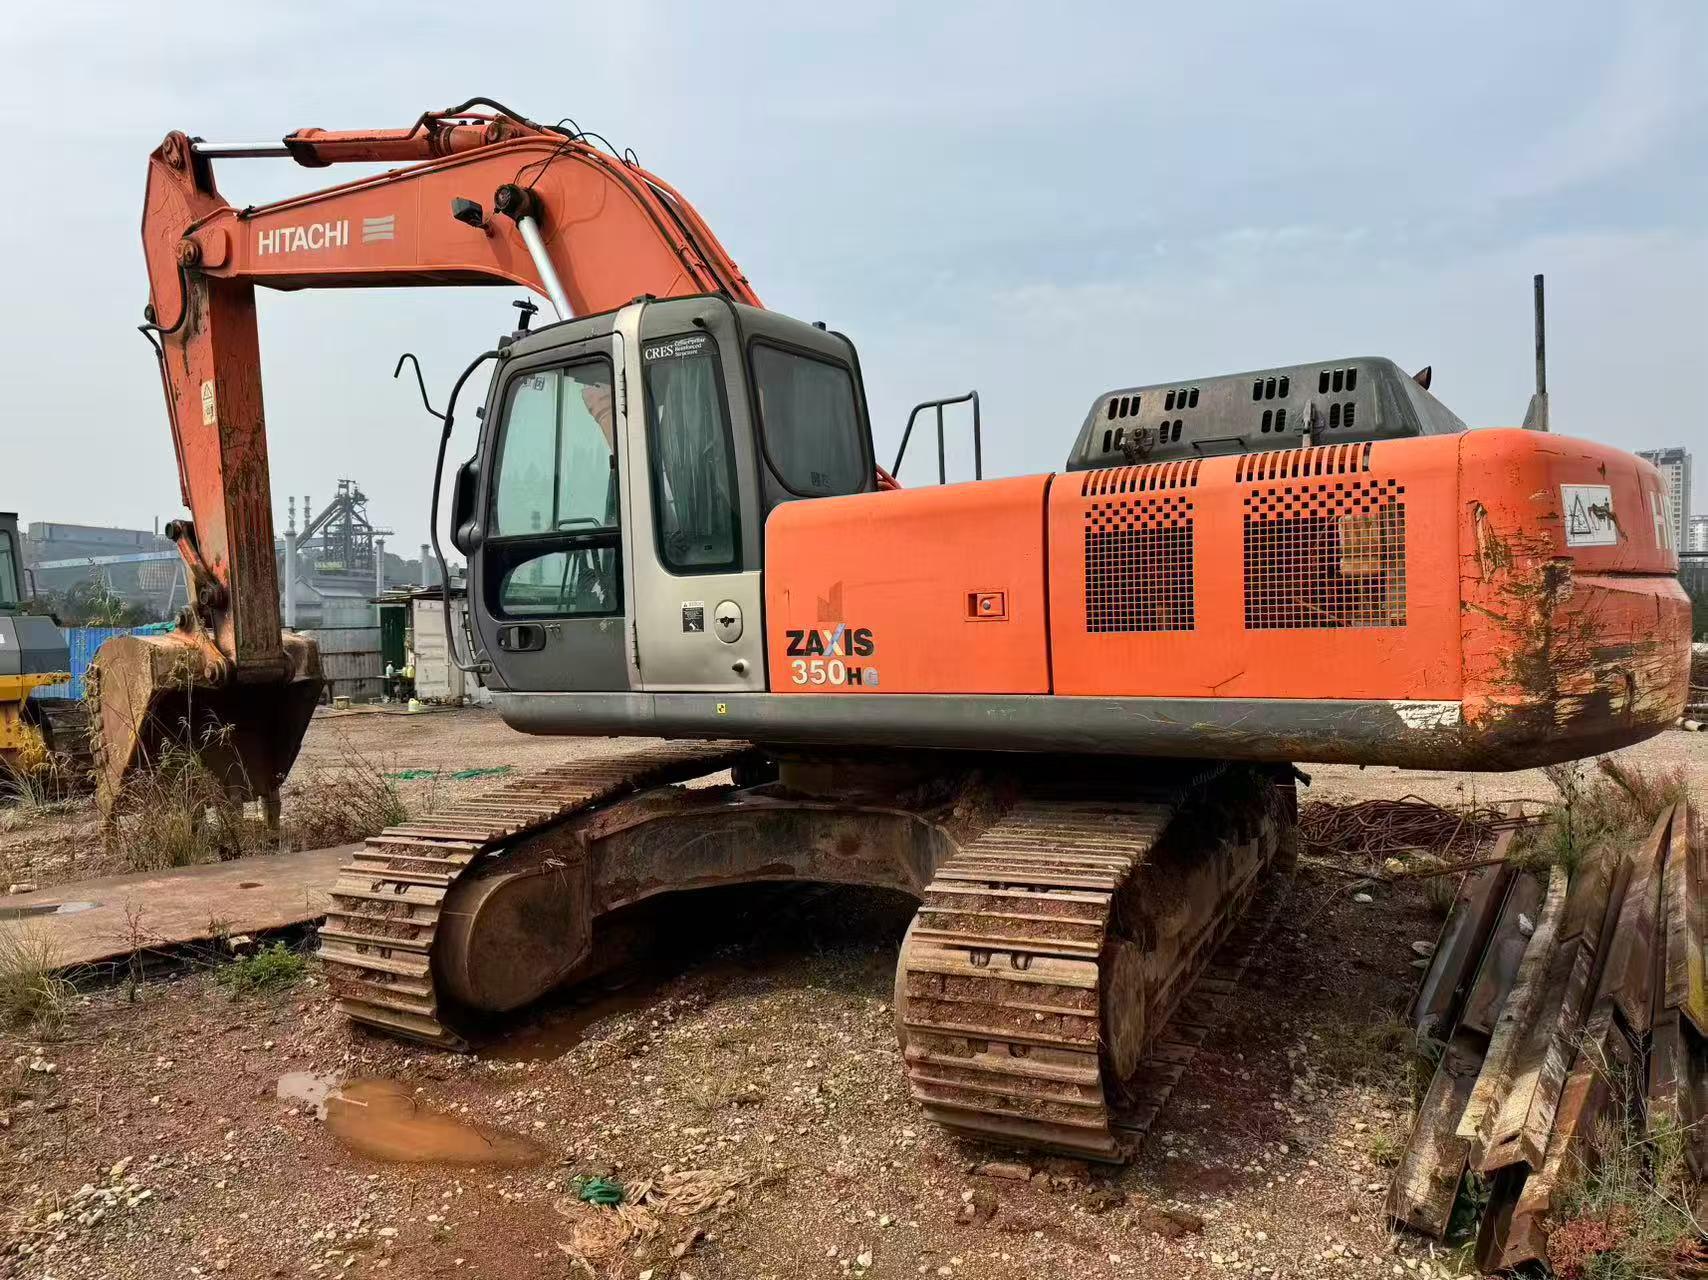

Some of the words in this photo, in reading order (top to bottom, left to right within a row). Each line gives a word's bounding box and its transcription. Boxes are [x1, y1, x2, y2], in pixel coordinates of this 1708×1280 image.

[258, 220, 349, 256] HITACHI
[645, 344, 674, 360] CRES
[785, 623, 875, 656] ZAXIS
[791, 659, 880, 687] 350HG
